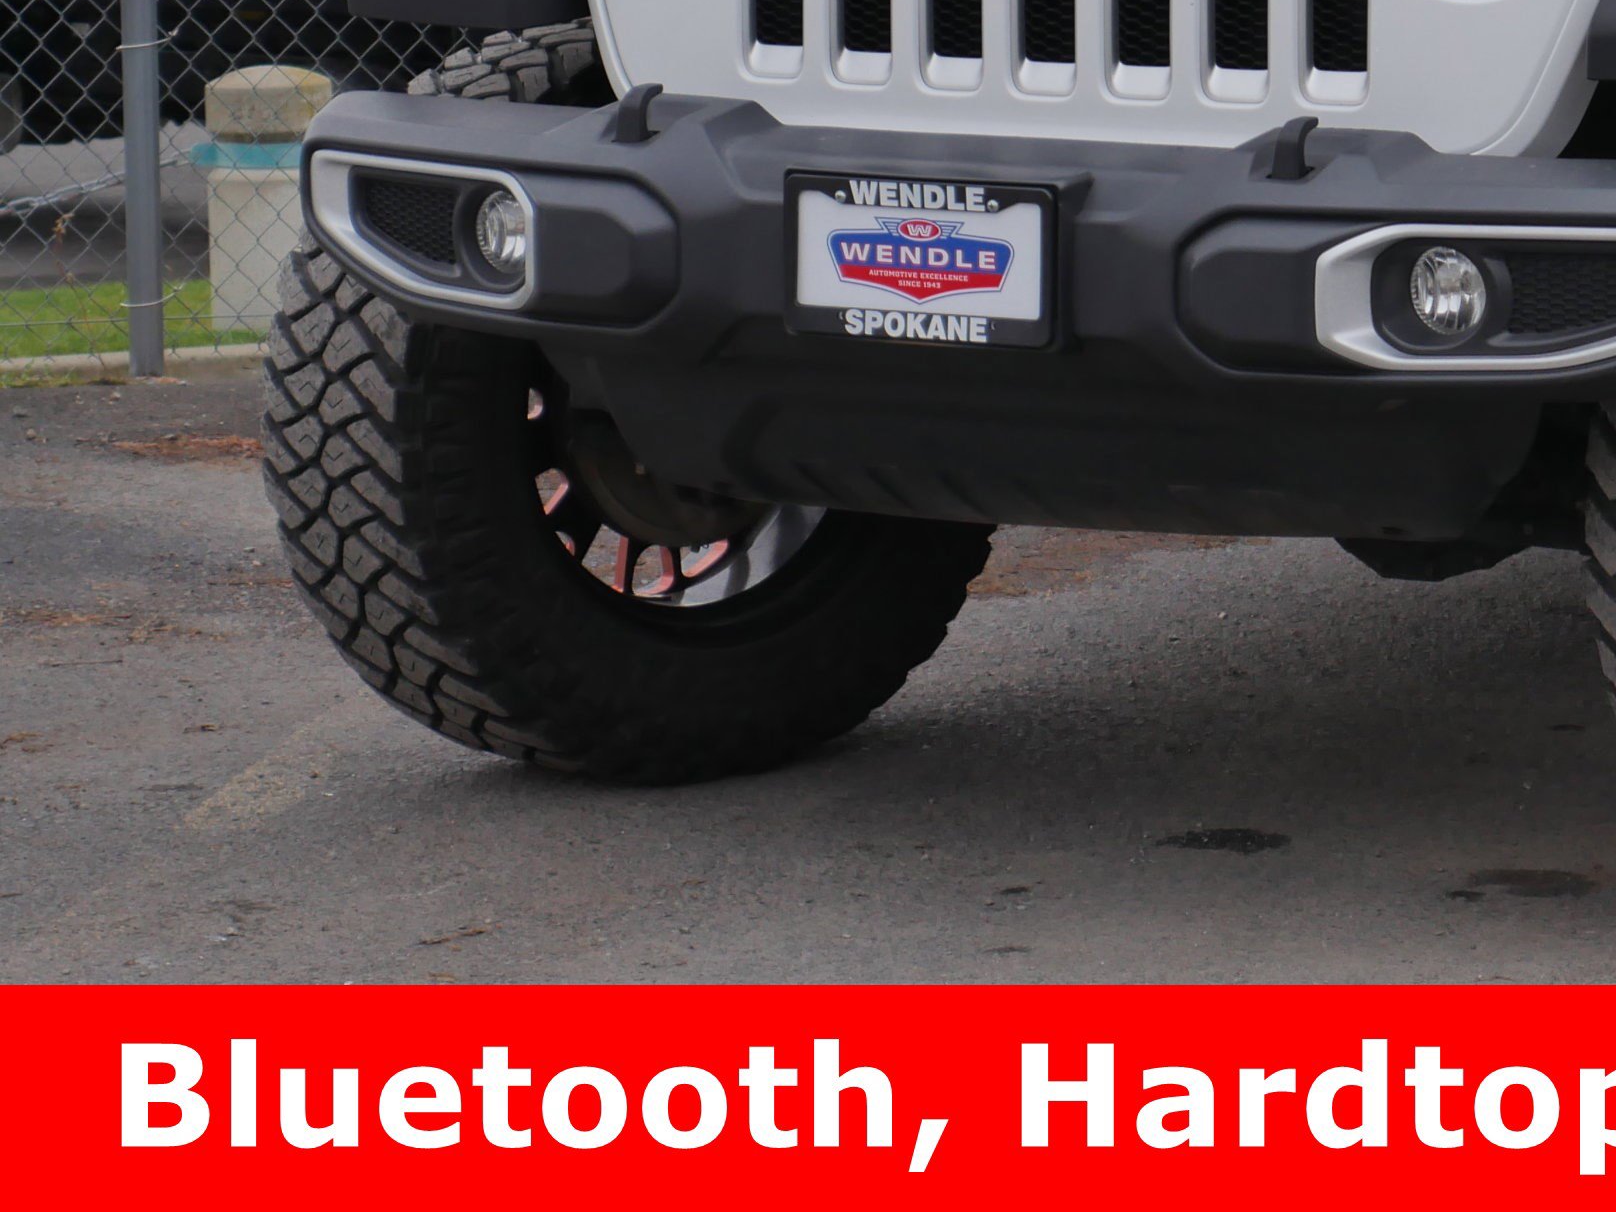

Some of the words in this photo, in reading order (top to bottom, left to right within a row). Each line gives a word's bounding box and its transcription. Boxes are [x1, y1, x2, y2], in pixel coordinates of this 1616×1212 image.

[849, 180, 985, 212] WENDLE
[840, 241, 996, 270] WENDLE
[869, 269, 918, 279] AUTOMOTIVE
[920, 272, 968, 282] EXCELLENCE
[898, 280, 921, 288] SINCE
[923, 281, 941, 289] 1943
[845, 308, 987, 343] SPOKANE
